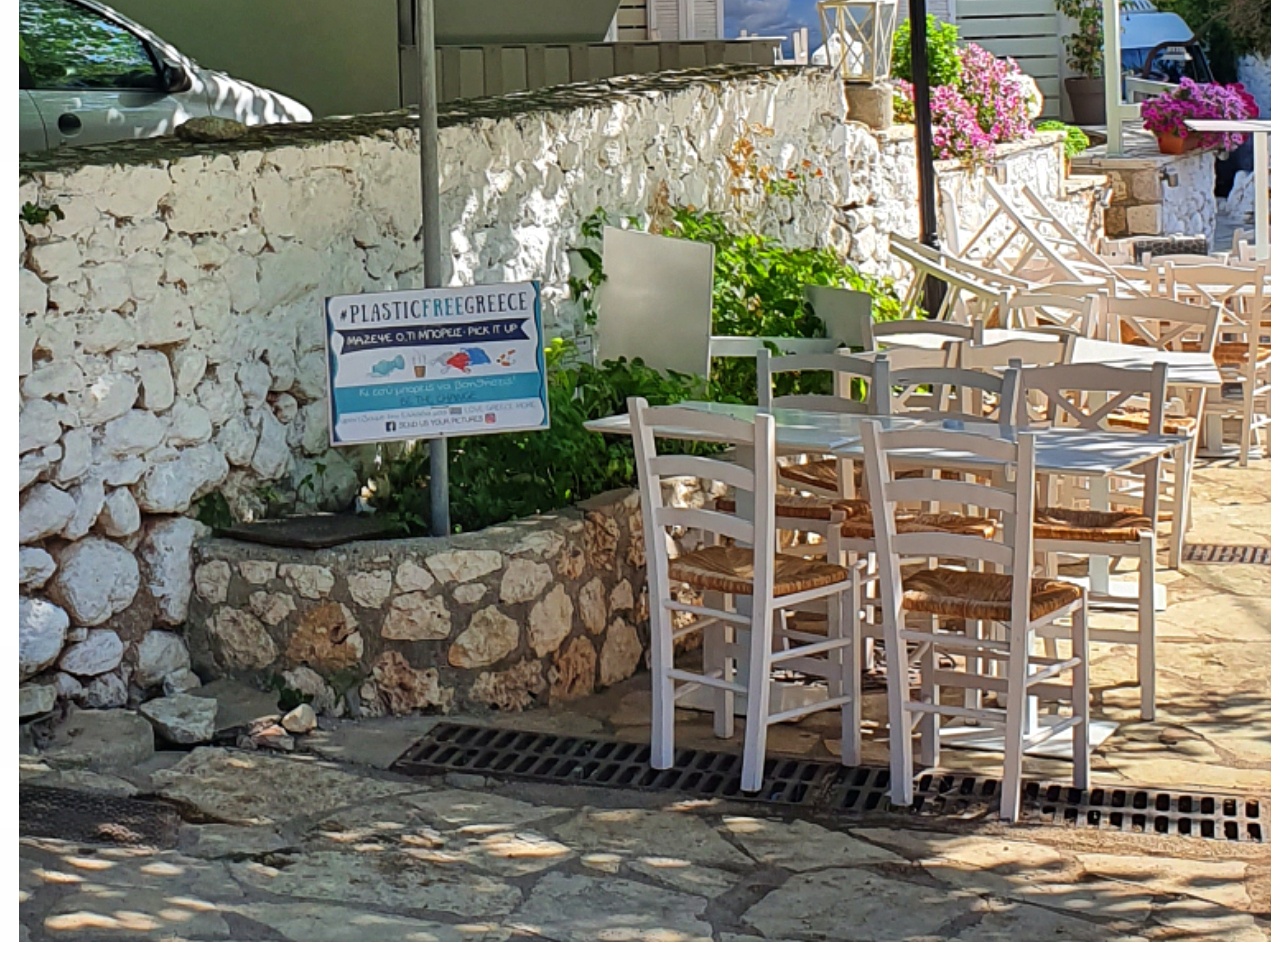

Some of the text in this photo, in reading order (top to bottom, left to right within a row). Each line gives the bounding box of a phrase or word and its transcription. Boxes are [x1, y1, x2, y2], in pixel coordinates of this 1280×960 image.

[340, 292, 528, 323] #PLASTICFREEGREECE
[467, 322, 518, 337] PICK IT UP
